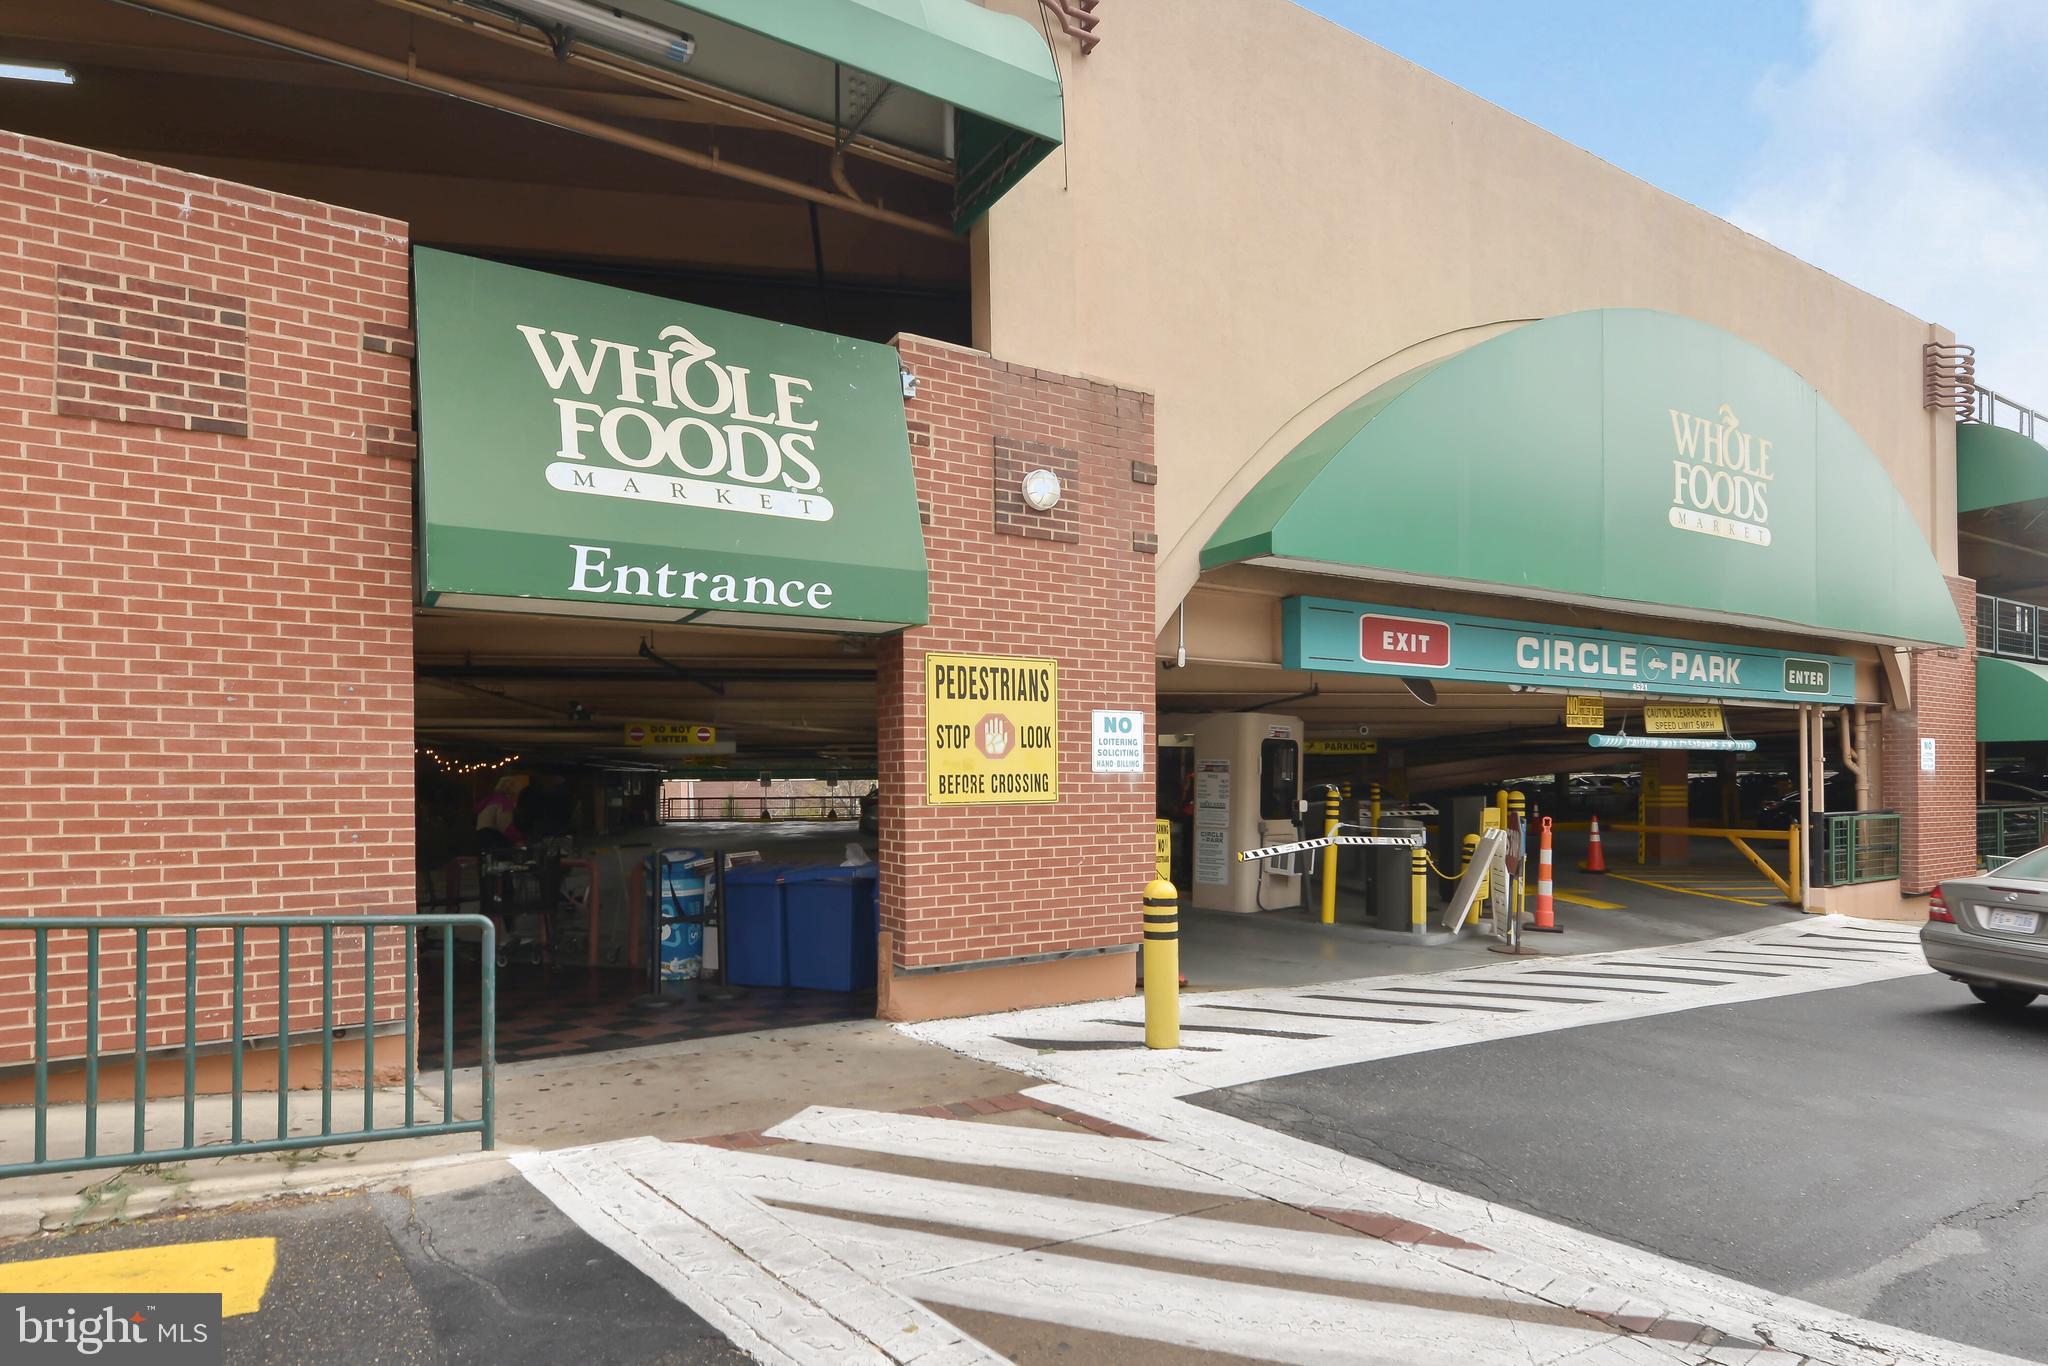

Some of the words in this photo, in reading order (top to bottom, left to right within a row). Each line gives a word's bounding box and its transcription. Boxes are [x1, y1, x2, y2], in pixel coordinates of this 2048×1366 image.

[516, 324, 819, 432] WHOLE
[552, 397, 822, 491] FOODS
[1668, 404, 1775, 481] WHOLE
[573, 469, 813, 515] MARKET
[1673, 460, 1768, 524] FOODS
[1678, 511, 1764, 542] MARKET
[567, 544, 833, 609] Entrance
[1383, 630, 1431, 654] EXIT
[1516, 636, 1638, 677] CIRCLE
[1671, 651, 1741, 685] PARK
[935, 664, 1049, 702] PEDESTRIANS
[1632, 682, 1648, 691] 4521
[1788, 669, 1824, 686] ENTER
[1566, 696, 1579, 715] NO
[1646, 707, 1671, 718] CAUTION
[1672, 707, 1707, 718] CLEARANCE
[1104, 717, 1132, 733] NO
[1655, 721, 1676, 730] SPEED
[1678, 721, 1694, 729] LIMIT
[655, 735, 688, 743] ENTER
[936, 724, 971, 749] STOP
[1021, 725, 1051, 749] LOOK
[1098, 738, 1138, 746] LOITERING
[1324, 742, 1367, 751] PARKING
[1097, 749, 1140, 757] SOLICITING
[939, 774, 985, 794] BEFORE
[991, 773, 1049, 793] CROSSING
